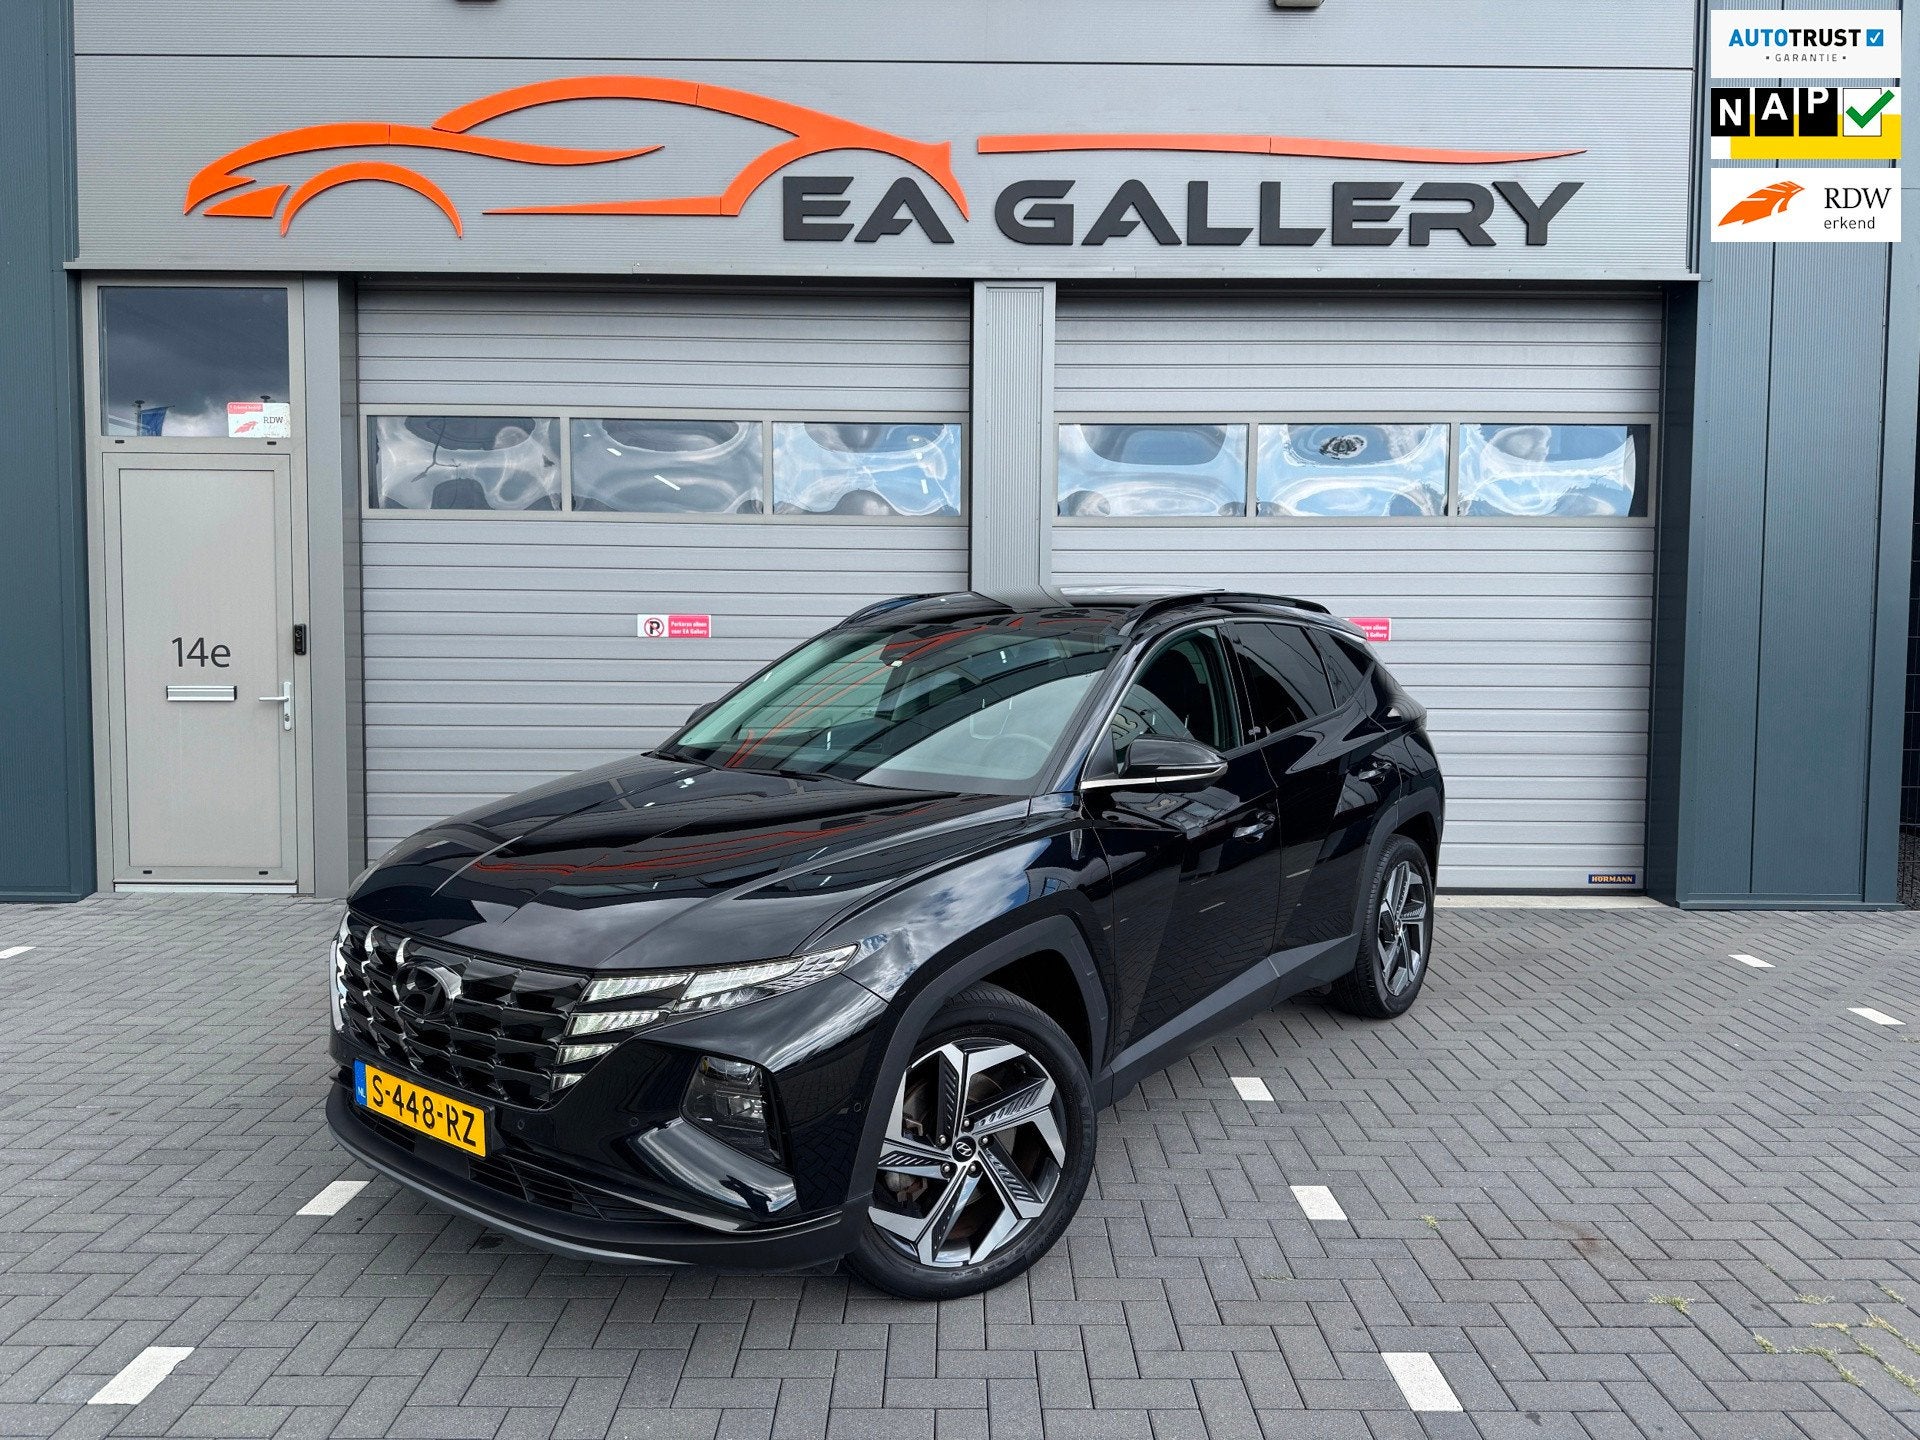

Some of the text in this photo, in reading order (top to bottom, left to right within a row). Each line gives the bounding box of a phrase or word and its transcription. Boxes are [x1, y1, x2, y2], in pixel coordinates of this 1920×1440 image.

[783, 176, 1585, 246] EA GALLERY
[263, 416, 284, 424] RDW
[171, 637, 231, 668] 14e
[372, 1074, 477, 1147] S-448-RZ
